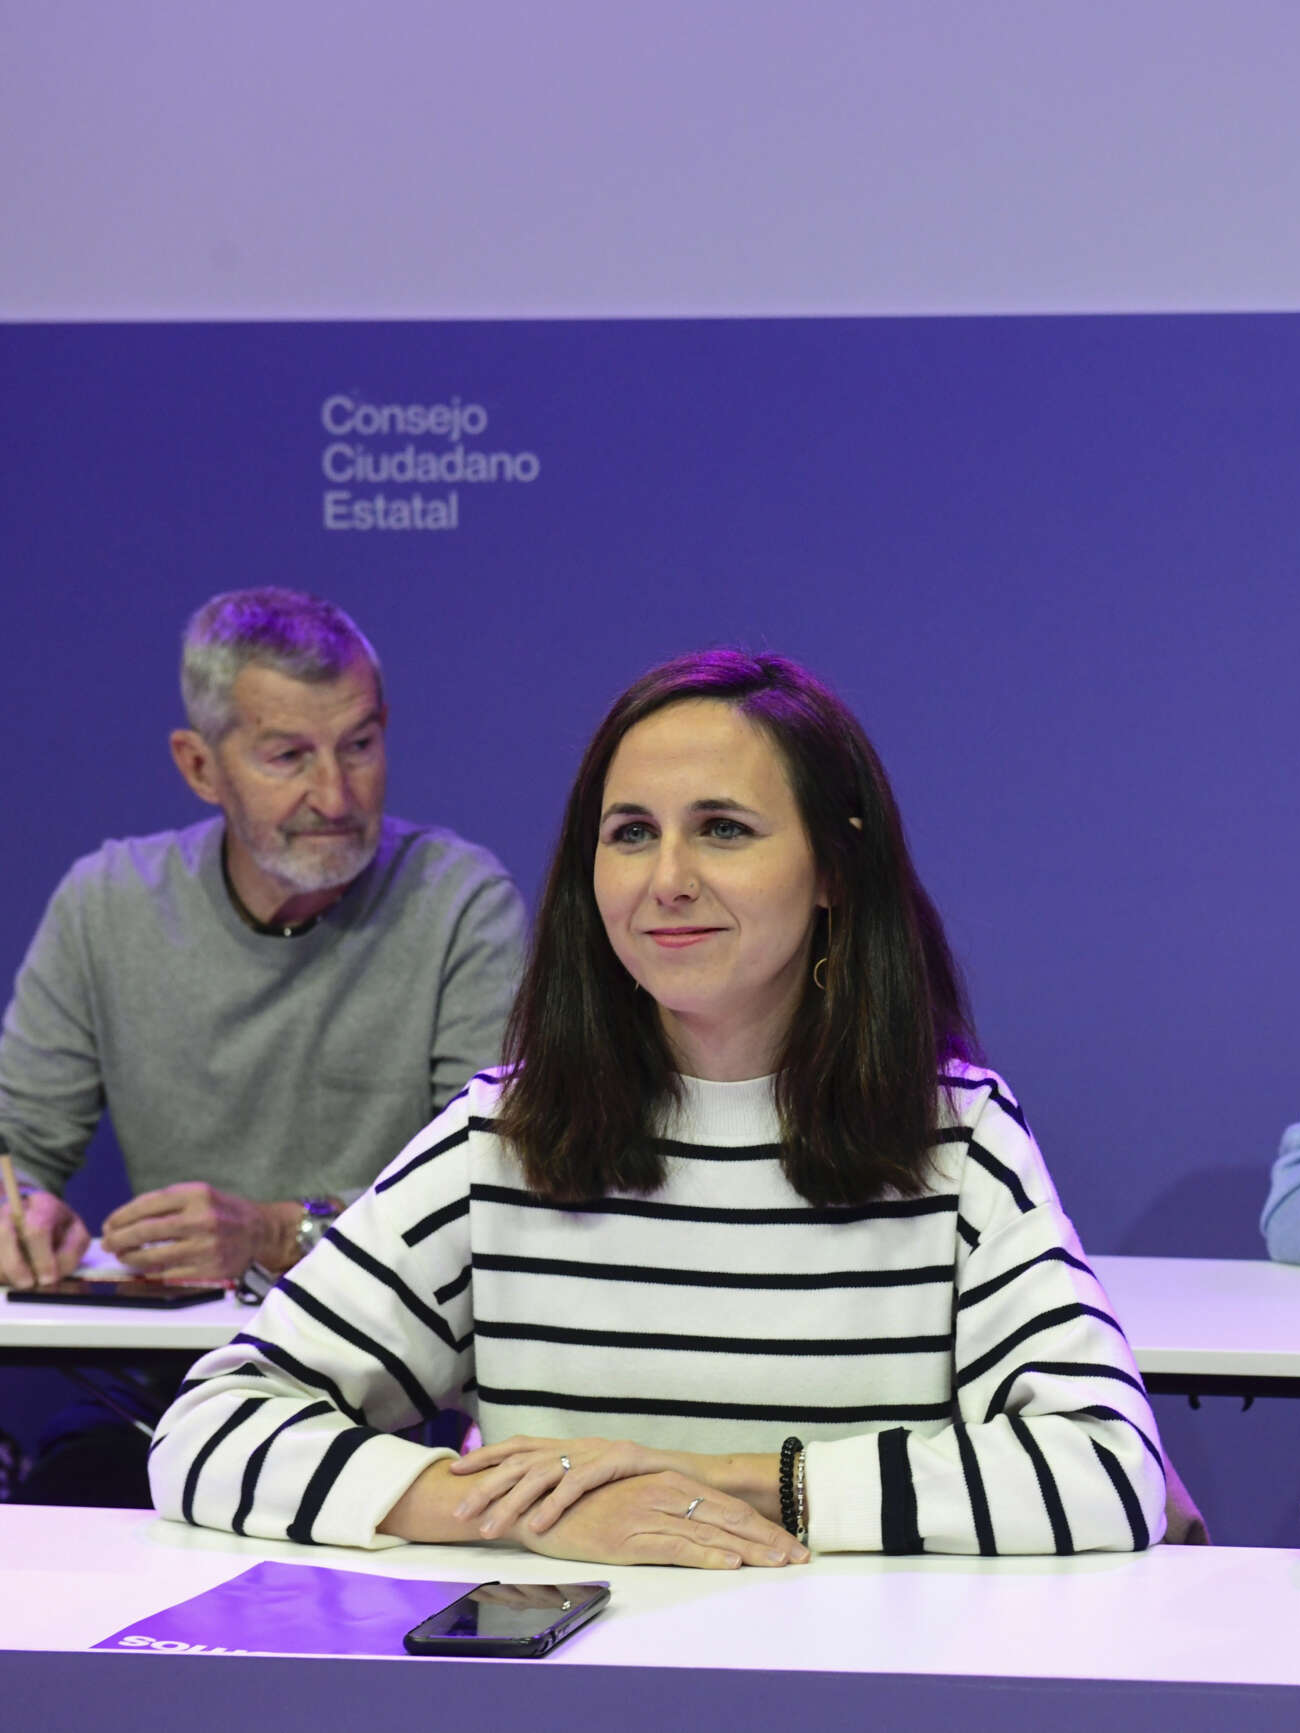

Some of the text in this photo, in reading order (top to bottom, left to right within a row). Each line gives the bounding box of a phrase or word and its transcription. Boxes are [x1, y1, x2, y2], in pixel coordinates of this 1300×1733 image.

[321, 394, 488, 442] Consejo
[321, 442, 541, 483] Ciudadano
[323, 490, 459, 530] Estatal
